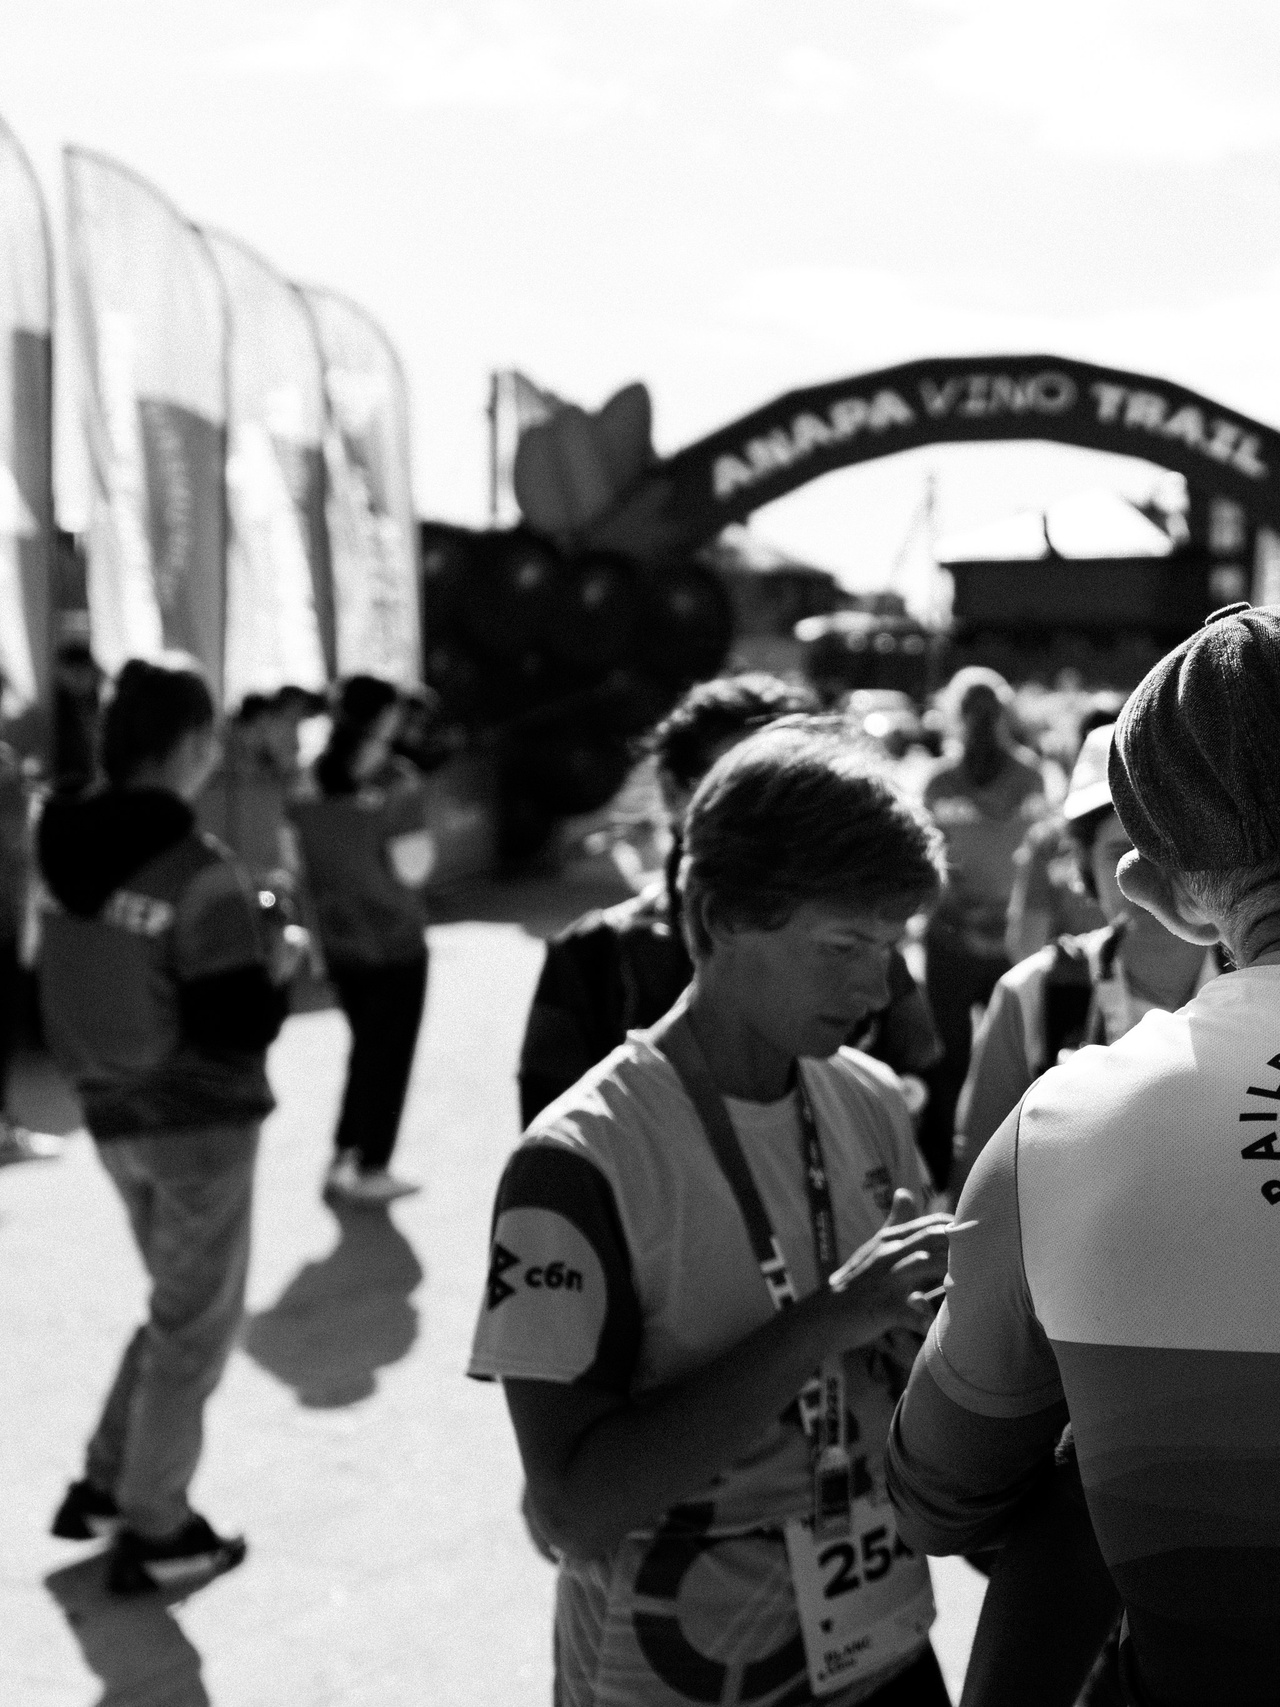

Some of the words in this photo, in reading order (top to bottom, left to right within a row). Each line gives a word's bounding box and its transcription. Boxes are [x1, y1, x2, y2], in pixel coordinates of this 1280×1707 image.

[713, 390, 917, 497] ANAPA
[919, 370, 1078, 418] VINO
[1090, 382, 1270, 478] TRAIL
[524, 1260, 584, 1293] сбп
